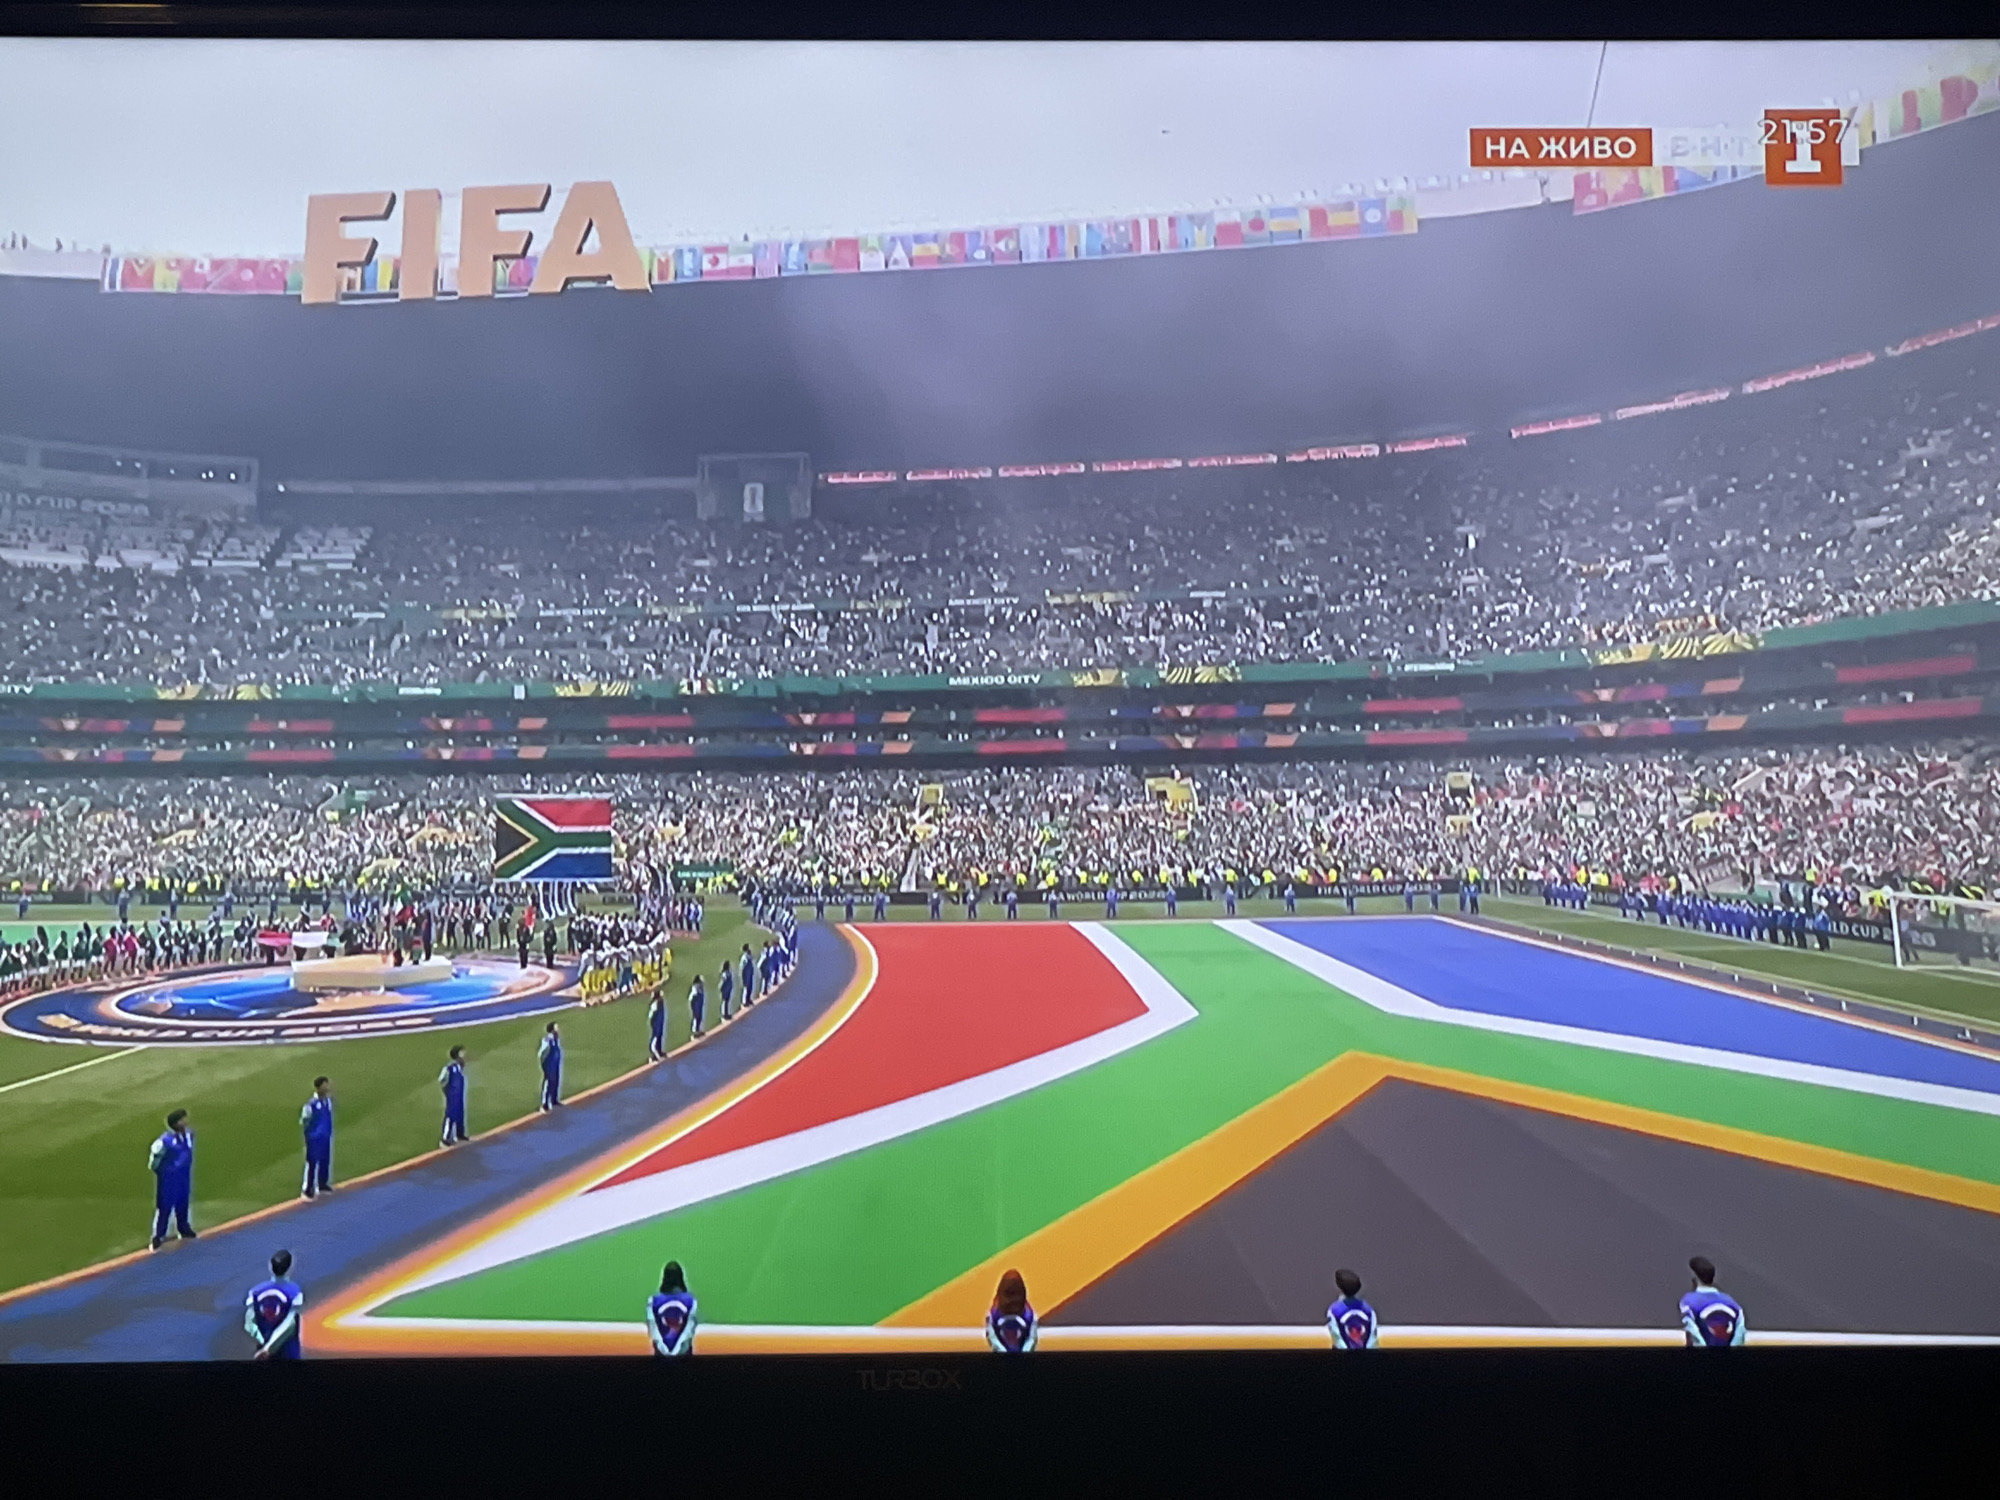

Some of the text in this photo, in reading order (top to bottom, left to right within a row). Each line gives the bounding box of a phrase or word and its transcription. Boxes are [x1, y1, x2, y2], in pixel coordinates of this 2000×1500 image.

[1484, 135, 1637, 160] НА ЖИВО
[301, 180, 652, 304] FIFA
[1851, 921, 1880, 939] CUP
